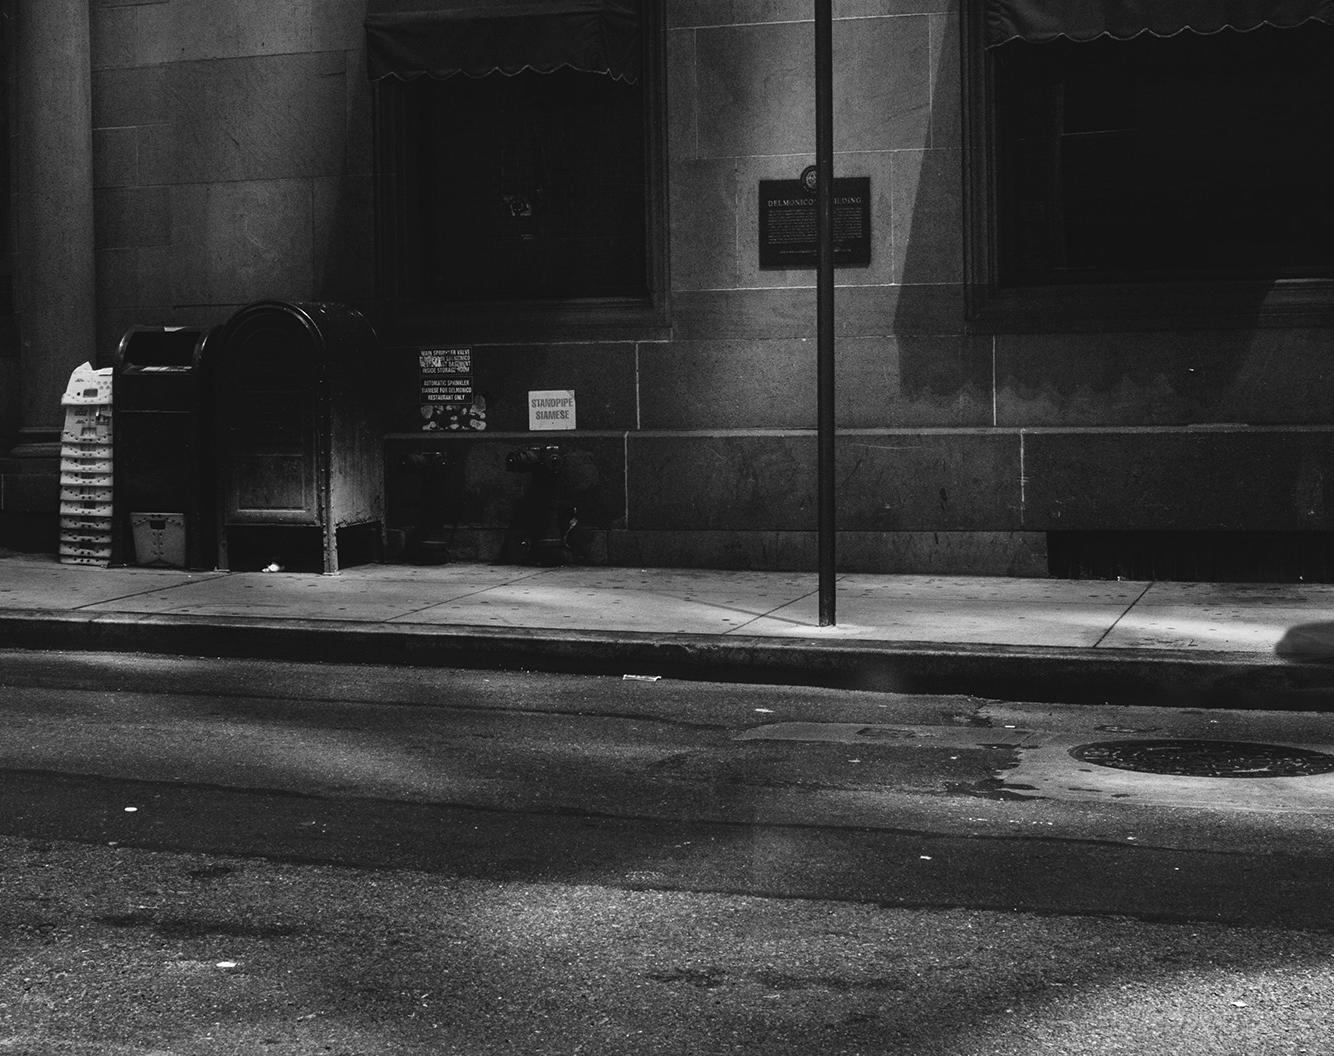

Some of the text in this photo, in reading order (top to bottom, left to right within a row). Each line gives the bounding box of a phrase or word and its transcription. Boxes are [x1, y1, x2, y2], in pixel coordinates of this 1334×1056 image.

[834, 196, 862, 205] ILDING
[531, 398, 573, 408] STANDPIPE
[535, 410, 570, 420] SIAMESE
